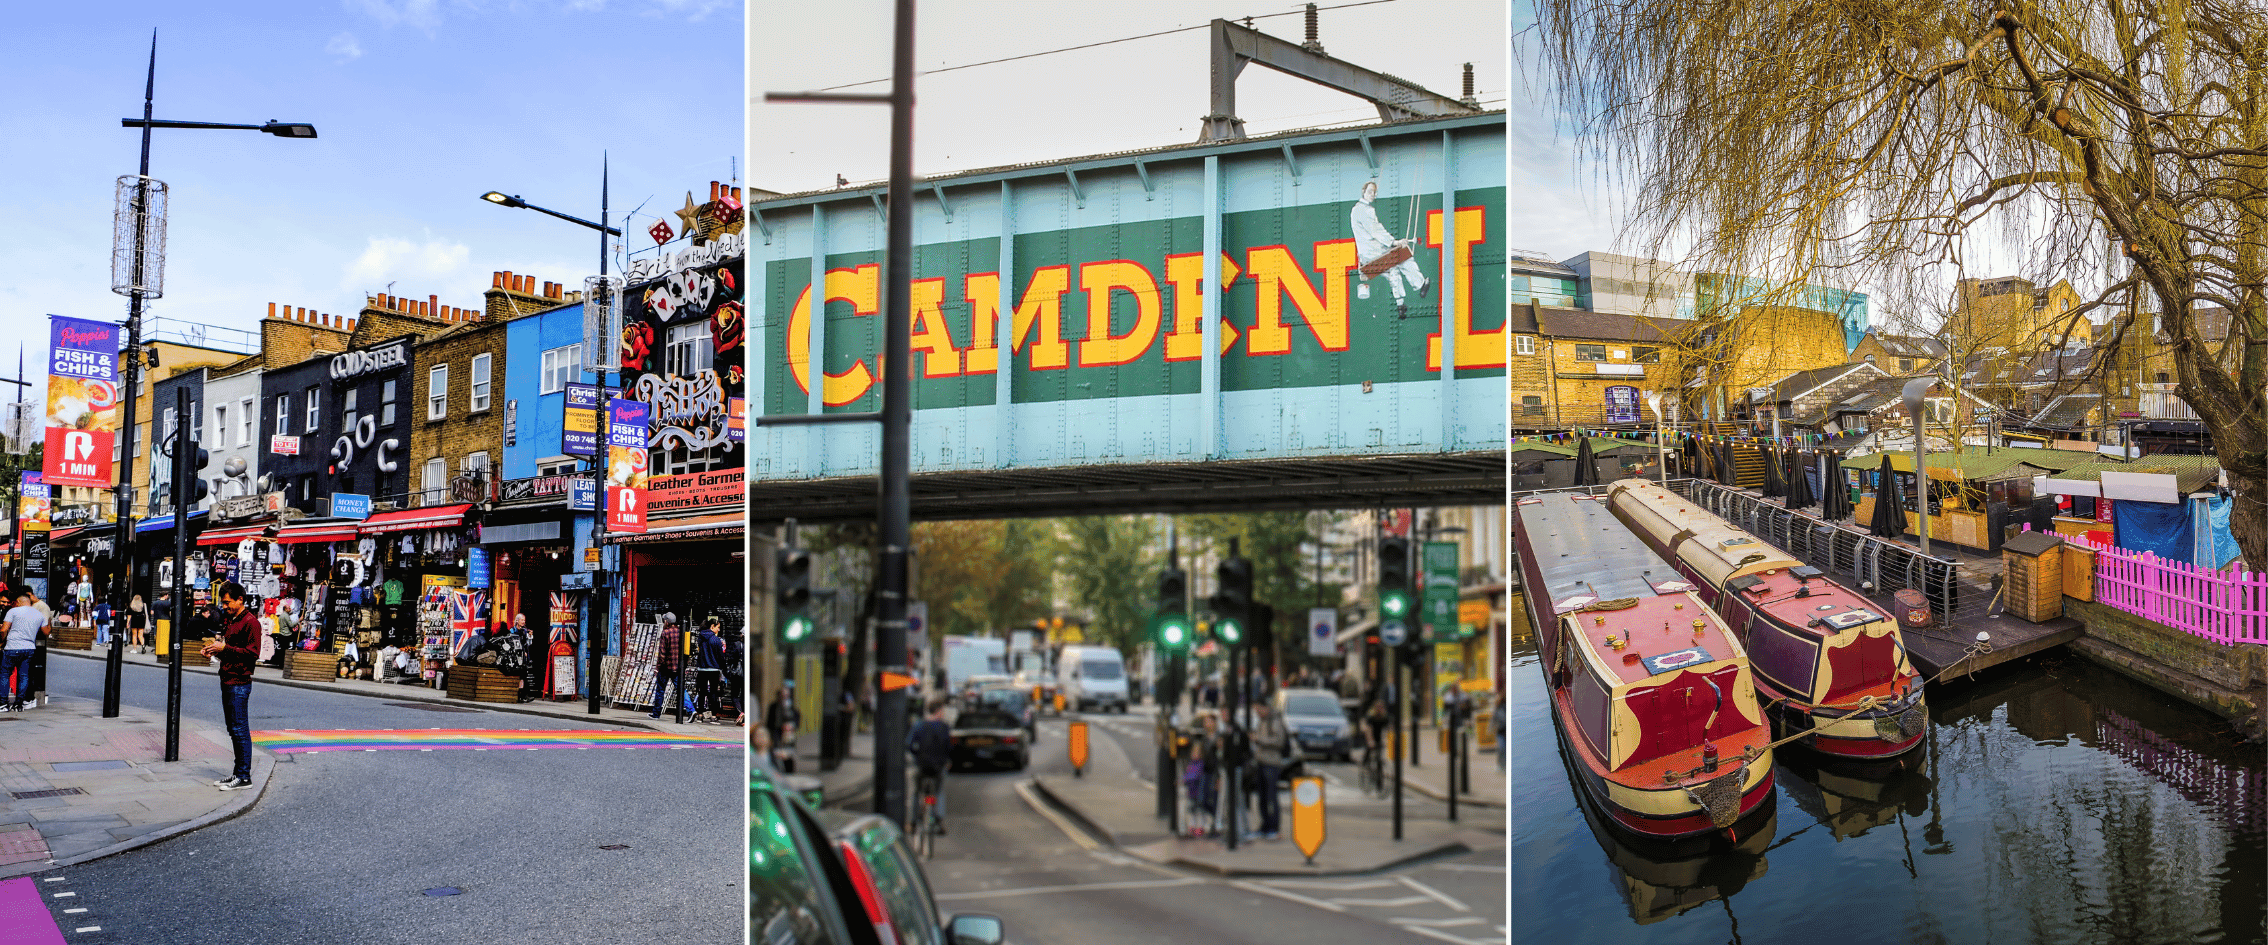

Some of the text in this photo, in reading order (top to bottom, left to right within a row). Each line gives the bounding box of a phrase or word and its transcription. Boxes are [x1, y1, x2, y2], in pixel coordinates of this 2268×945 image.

[786, 236, 1358, 408] CAMDEN
[55, 349, 112, 366] FISH &
[55, 361, 112, 377] CHIPS
[570, 388, 598, 398] Christ
[612, 425, 645, 437] FISH &
[730, 430, 744, 438] 020
[565, 434, 580, 442] 020
[612, 434, 645, 446] CHIPS
[60, 462, 96, 476] 1 MIN
[532, 473, 585, 496] TATTO
[648, 478, 695, 492] Leather
[337, 499, 365, 507] MONEY
[647, 497, 691, 510] ouvenirs
[692, 496, 701, 506] &
[335, 505, 366, 514] CHANGE
[617, 513, 638, 524] 1 MIN
[551, 610, 578, 623] LONDON
